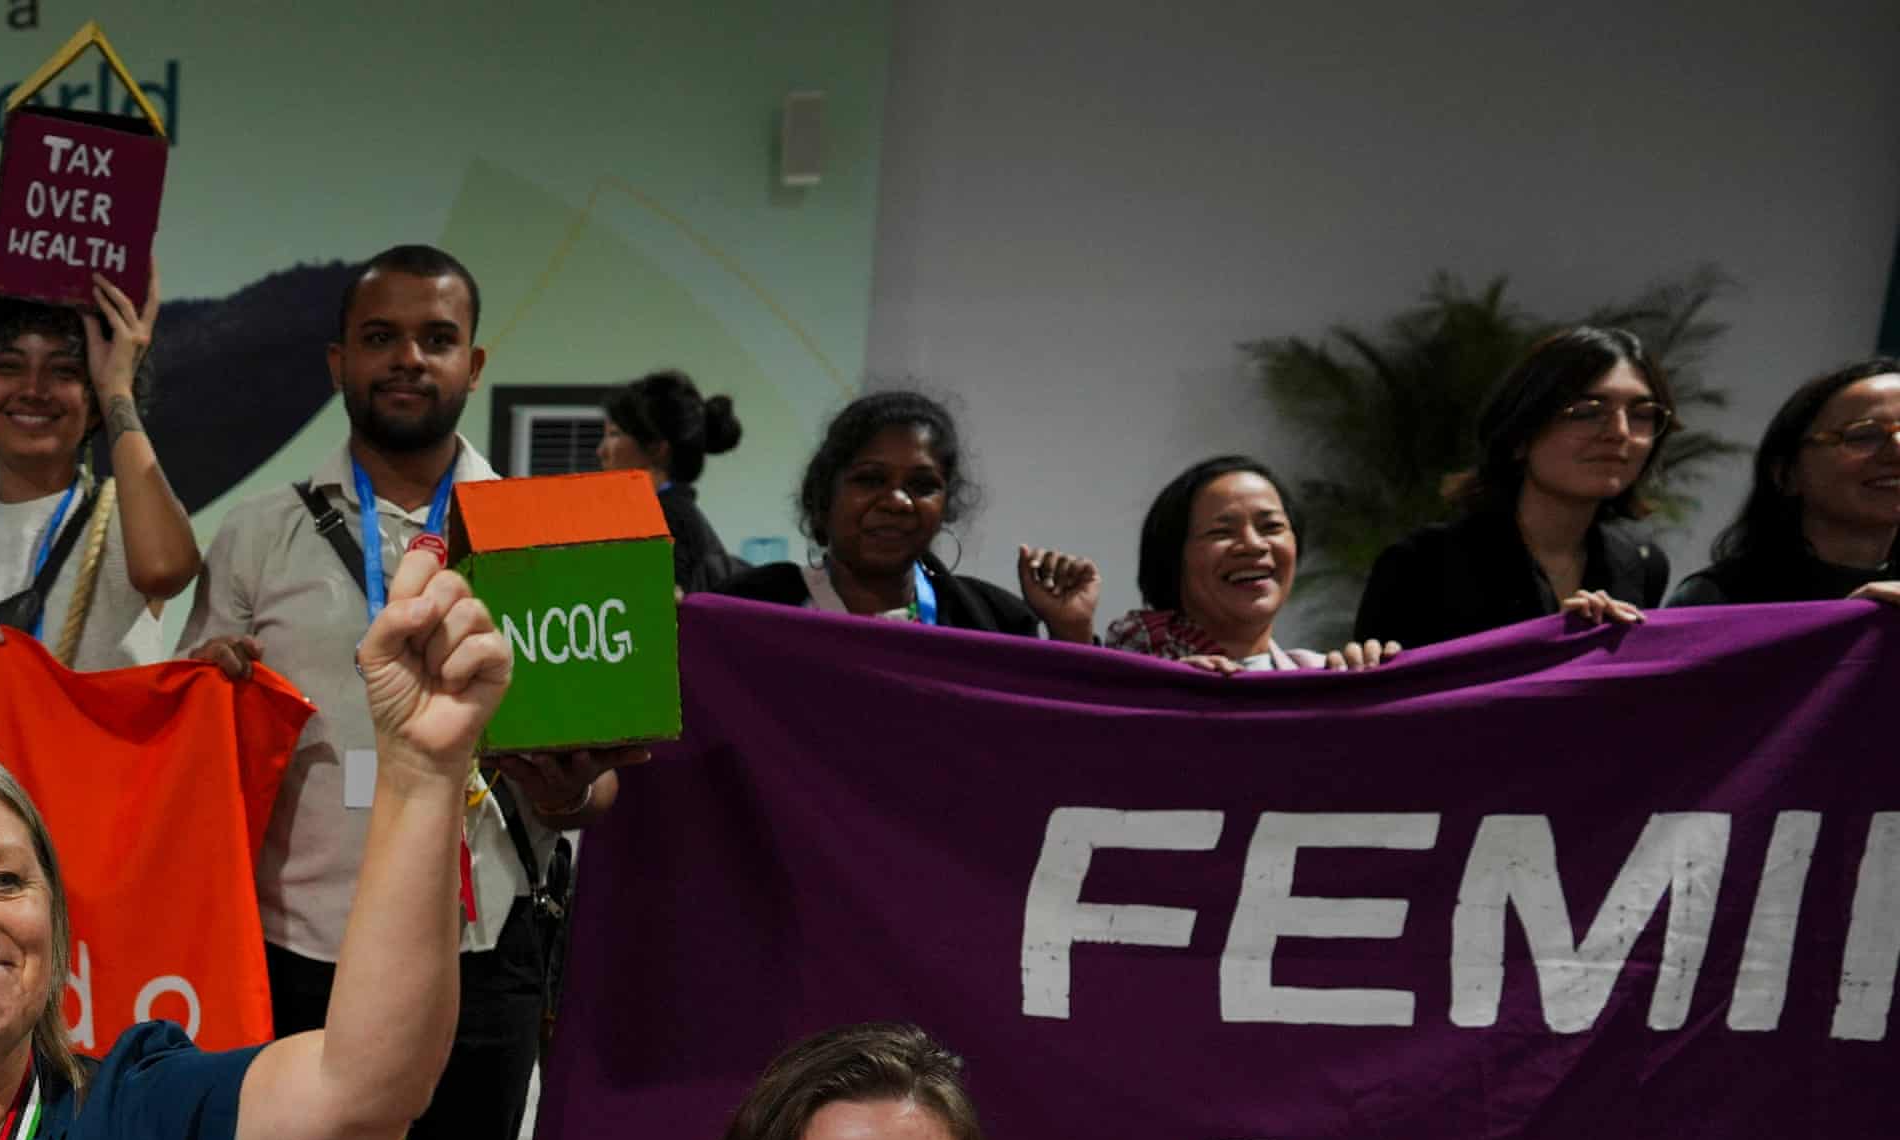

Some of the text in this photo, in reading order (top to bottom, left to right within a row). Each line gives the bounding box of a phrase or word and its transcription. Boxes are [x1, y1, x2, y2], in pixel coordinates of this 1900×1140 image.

[42, 134, 114, 178] TAX
[25, 181, 113, 227] OVER
[7, 227, 127, 273] WEALTH
[502, 598, 633, 664] NCQG
